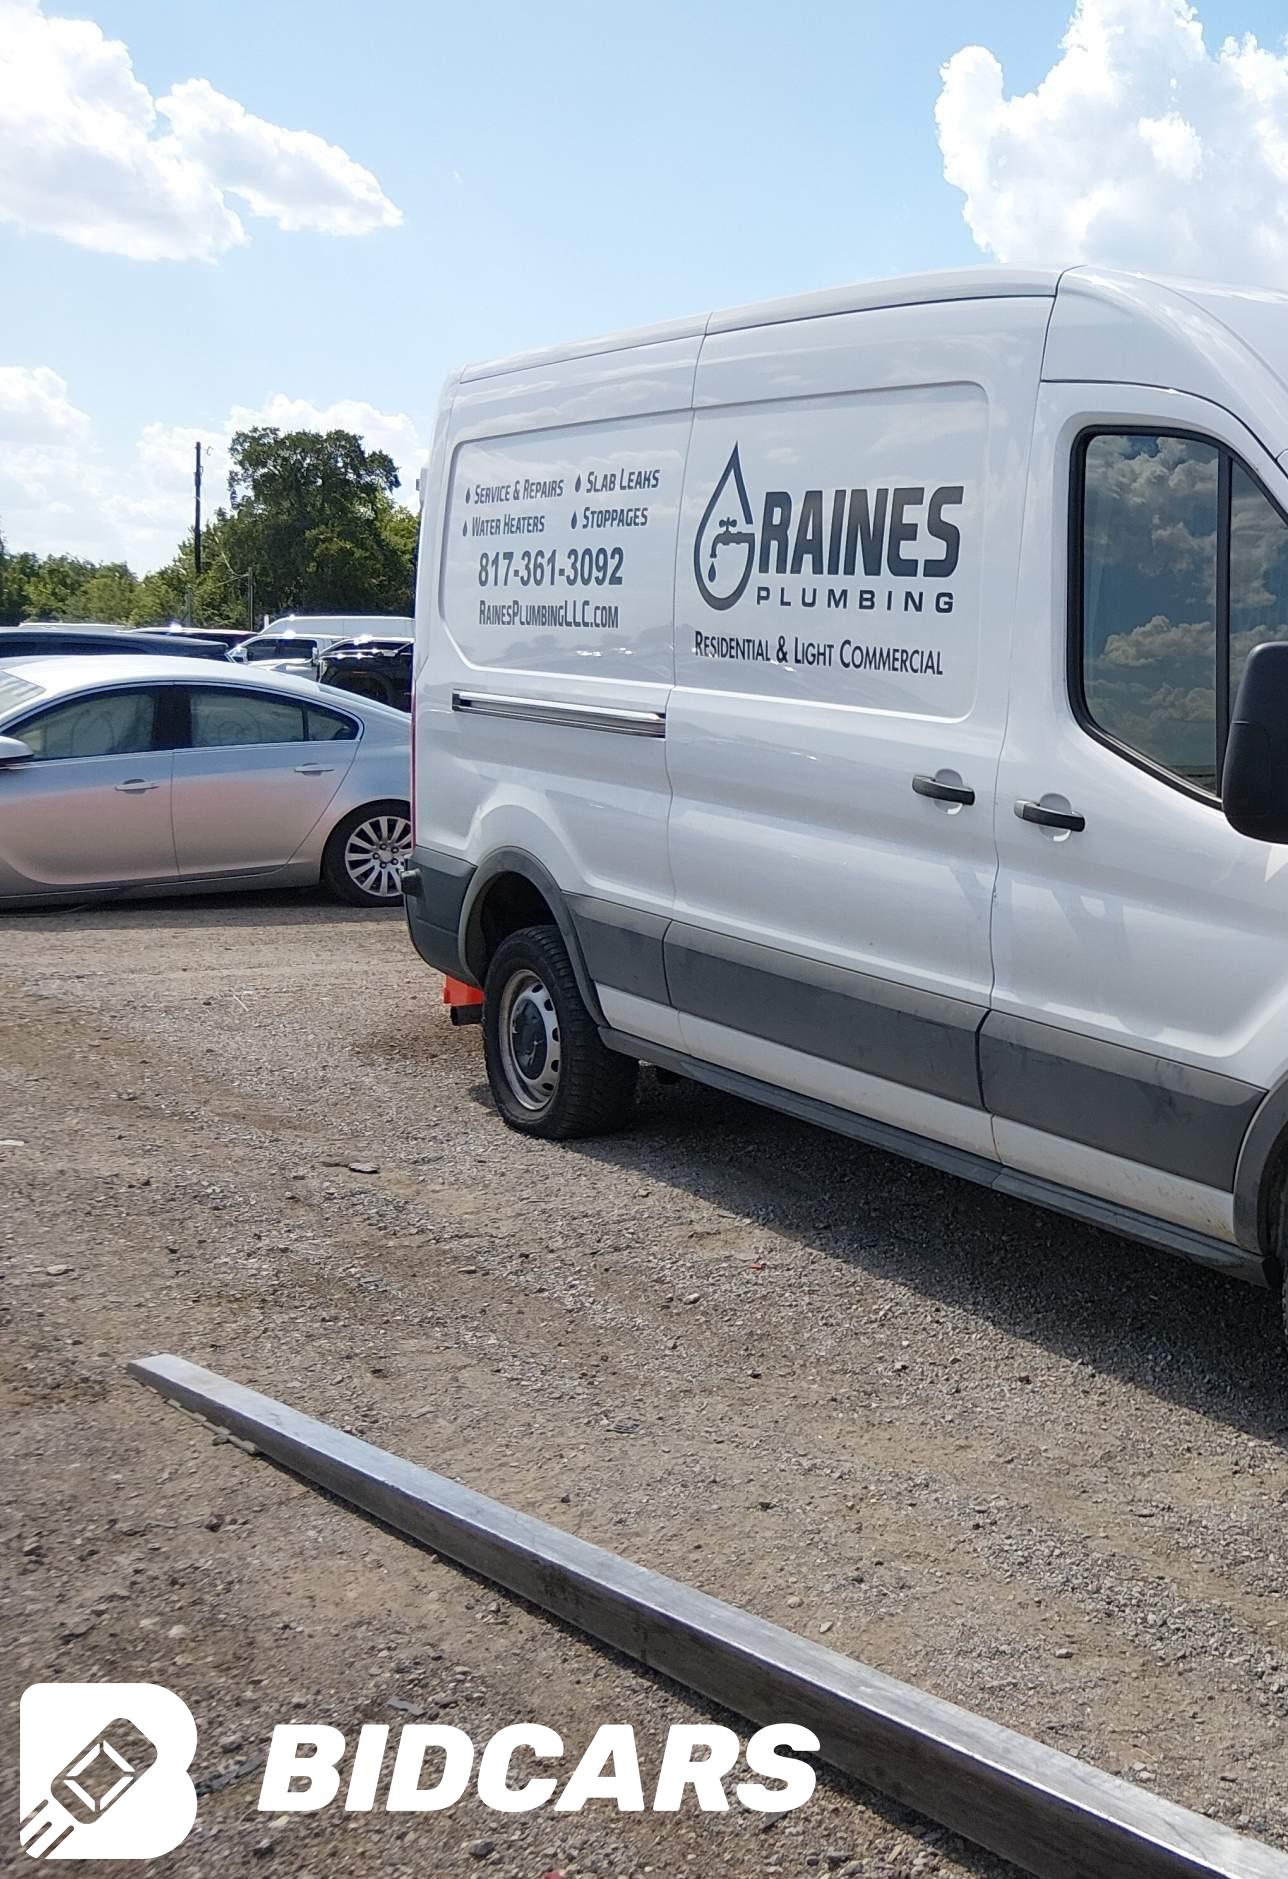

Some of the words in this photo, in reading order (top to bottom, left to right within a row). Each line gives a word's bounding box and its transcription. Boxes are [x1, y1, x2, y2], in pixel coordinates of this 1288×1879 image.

[513, 481, 521, 500] &
[478, 547, 625, 587] 817-361-3092
[756, 586, 955, 614] PLUMBING
[775, 635, 789, 664] &
